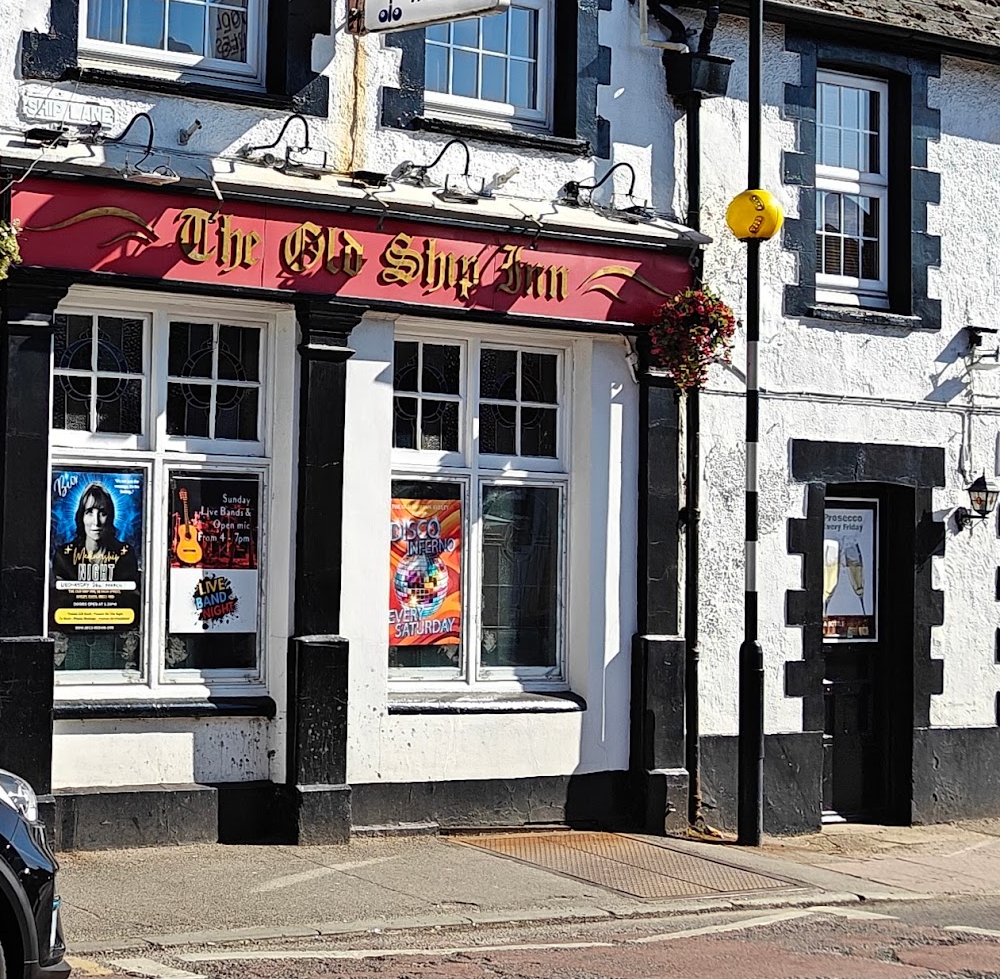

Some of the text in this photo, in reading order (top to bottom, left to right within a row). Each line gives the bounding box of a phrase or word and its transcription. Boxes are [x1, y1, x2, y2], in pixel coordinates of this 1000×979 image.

[68, 104, 114, 126] LANE
[179, 207, 571, 300] The Old Ship Inn
[222, 493, 251, 508] Sunday
[200, 506, 252, 517] Live Bands &
[212, 520, 251, 534] Open mic
[390, 518, 441, 542] DISCO
[842, 523, 863, 533] Friday
[197, 532, 218, 542] From
[219, 532, 226, 543] 4
[234, 532, 250, 544] 7pm
[407, 538, 456, 556] INFERNO
[78, 563, 116, 581] NIGHT
[198, 577, 226, 596] LIVE
[195, 592, 227, 610] BAND
[201, 601, 236, 620] NIGHT
[388, 607, 425, 624] EVERY
[395, 618, 456, 639] SATURDAY
